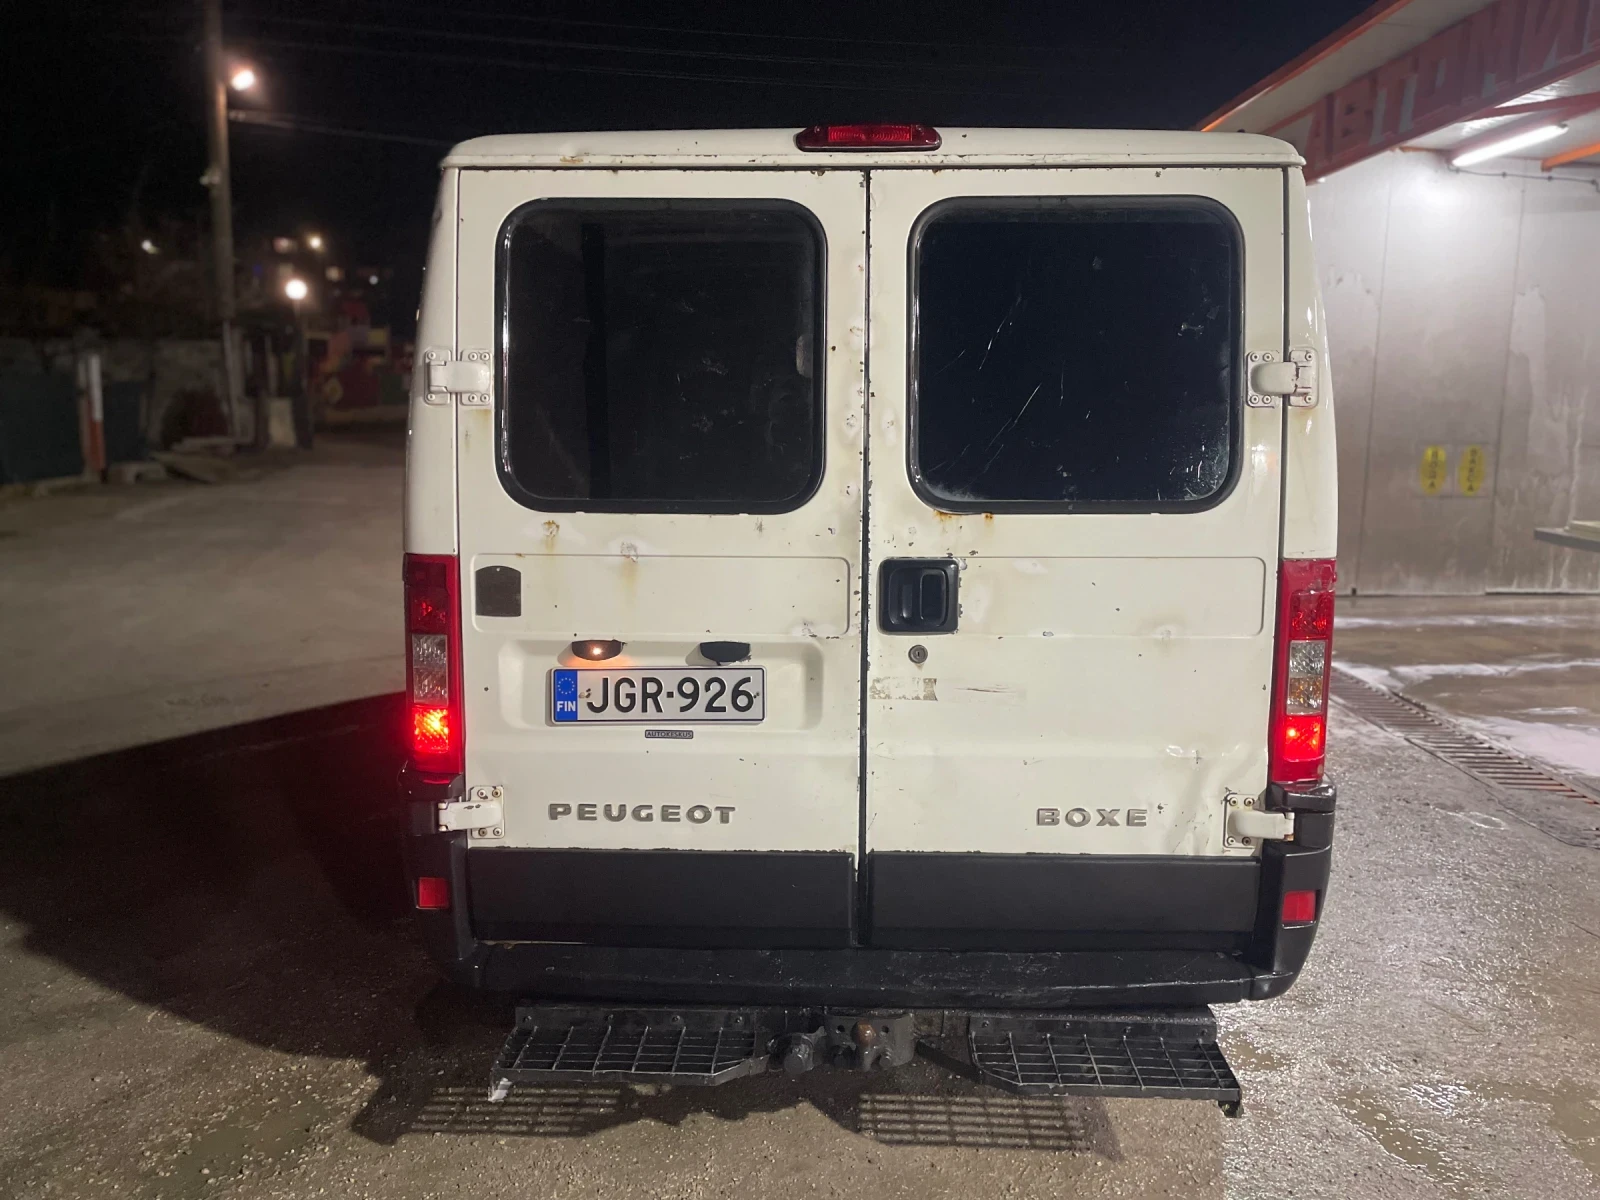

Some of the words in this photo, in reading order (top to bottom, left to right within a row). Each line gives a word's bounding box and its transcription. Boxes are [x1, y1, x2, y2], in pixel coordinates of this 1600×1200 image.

[556, 701, 576, 712] FIN
[586, 676, 755, 714] JGR-926
[646, 730, 692, 738] AUTOKESKUS
[548, 803, 736, 825] PEUGEOT
[1036, 807, 1148, 828] BOXE
